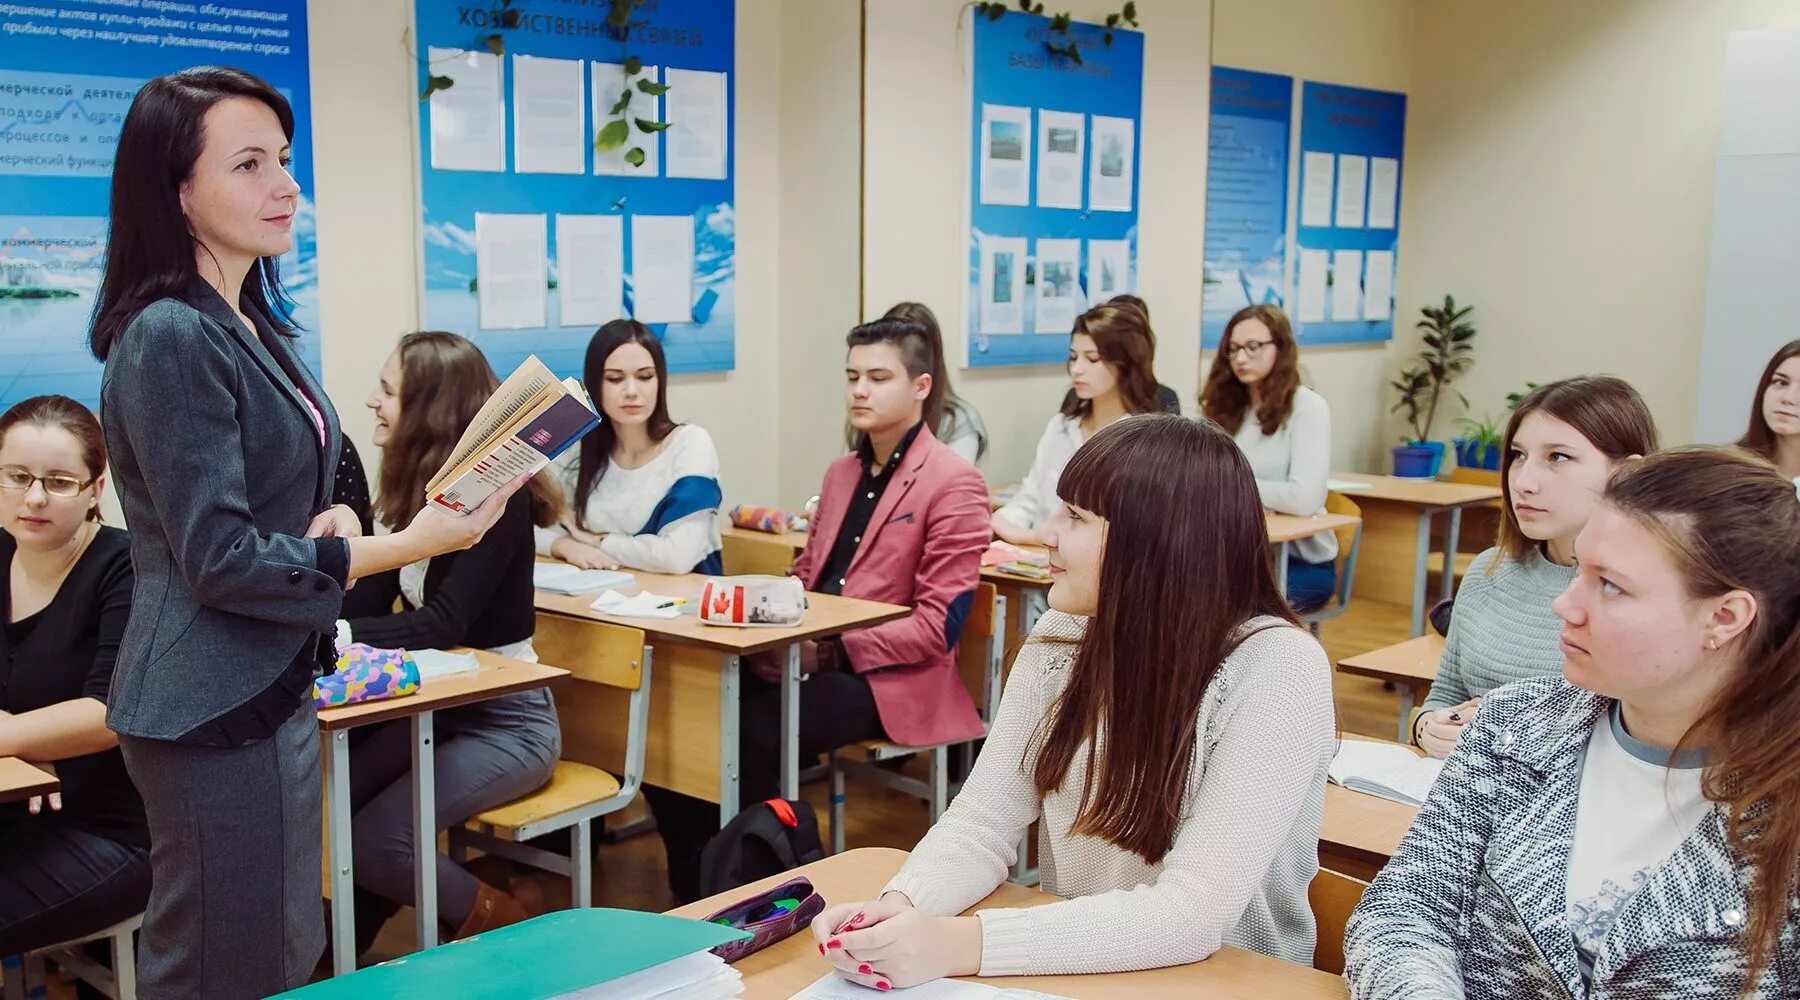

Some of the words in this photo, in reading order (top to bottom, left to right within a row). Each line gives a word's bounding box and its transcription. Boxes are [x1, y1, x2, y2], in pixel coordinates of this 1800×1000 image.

[199, 3, 289, 22] обслуживающие
[58, 9, 97, 20] актов
[99, 13, 188, 30] купли-продажи
[189, 21, 197, 31] с
[197, 22, 232, 34] целью
[233, 24, 289, 38] получения
[3, 21, 57, 36] прибыли
[59, 27, 94, 41] через
[95, 30, 159, 45] наилучшее
[160, 33, 254, 52] удовлетворение
[254, 43, 290, 55] спроса
[90, 111, 123, 124] орга
[79, 135, 88, 143] и
[66, 154, 112, 169] функци
[1, 235, 97, 251] коммерческой
